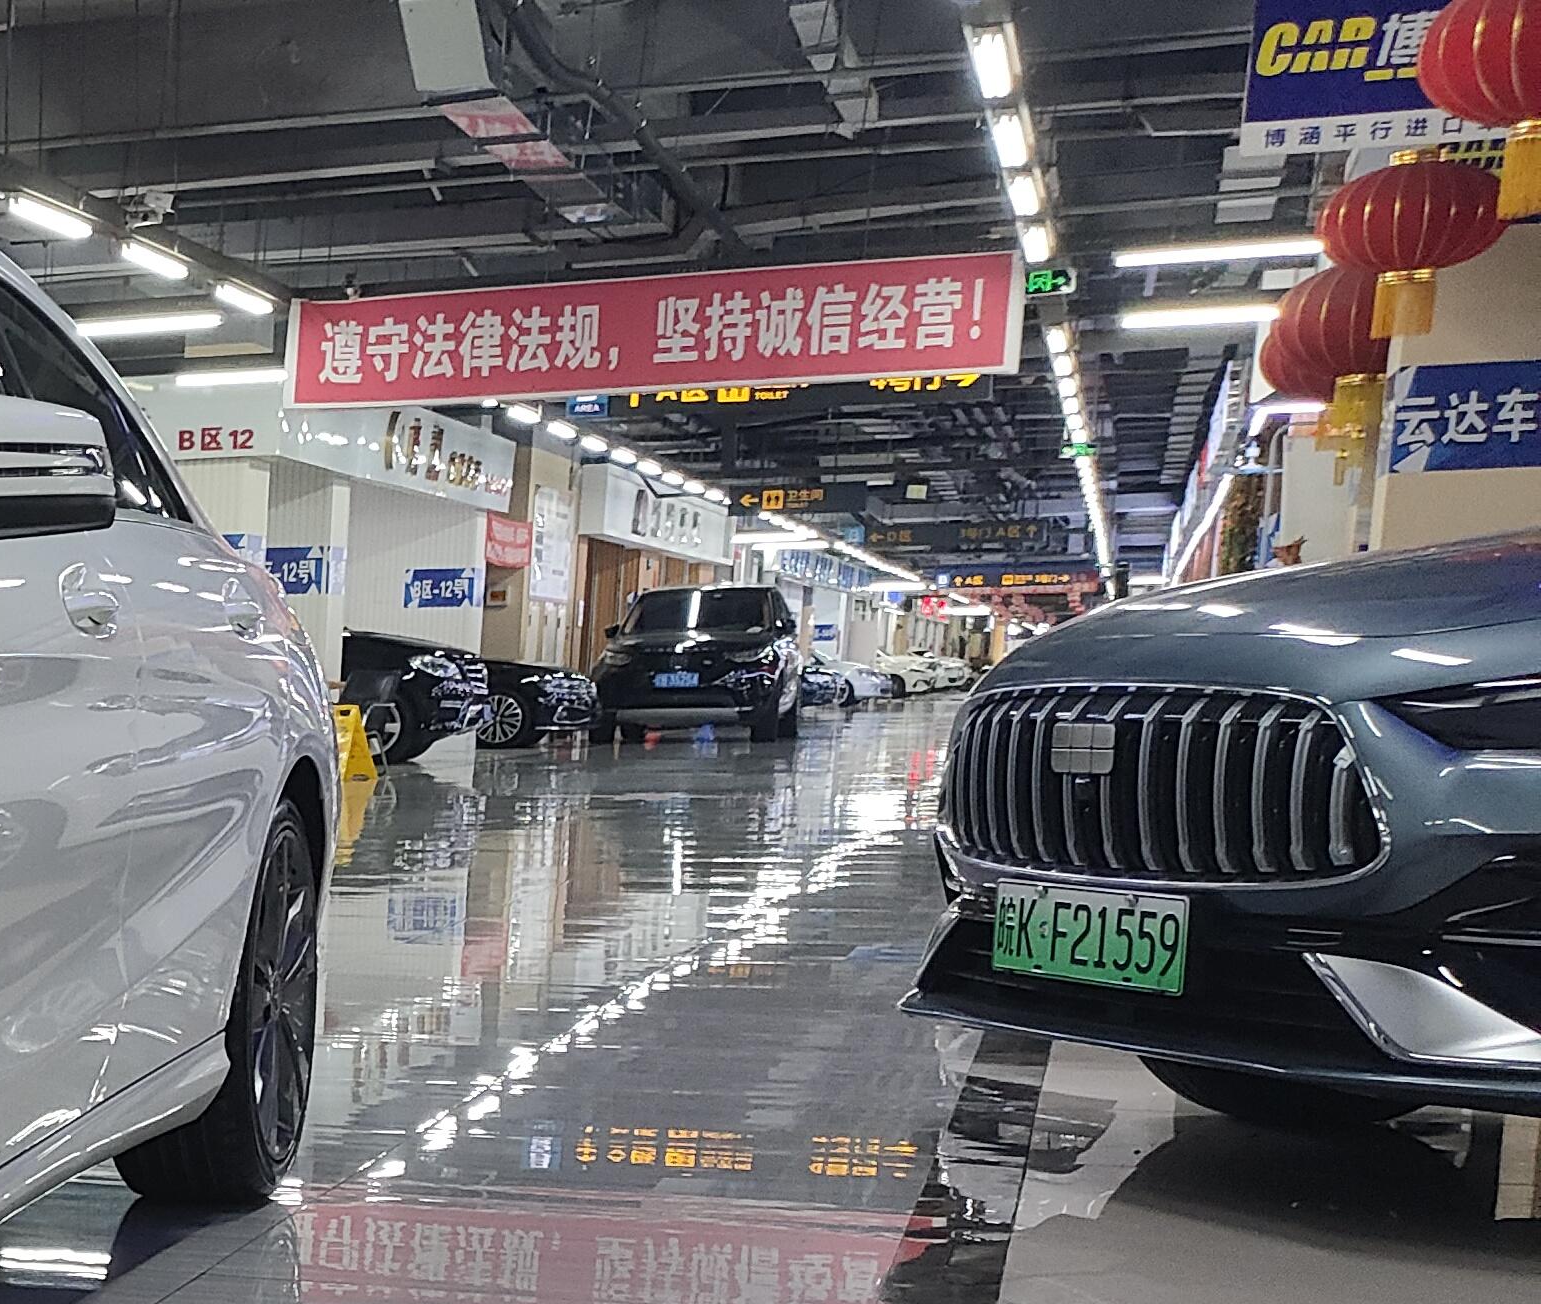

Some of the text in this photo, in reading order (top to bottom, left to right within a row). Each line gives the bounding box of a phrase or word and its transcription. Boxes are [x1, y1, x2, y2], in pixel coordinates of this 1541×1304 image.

[1256, 16, 1377, 76] CAR
[318, 277, 984, 384] 遵守法律法规，坚持诚信经营！
[179, 427, 254, 450] B 区 12
[1397, 388, 1539, 446] 云达车
[413, 577, 469, 600] B区-12号
